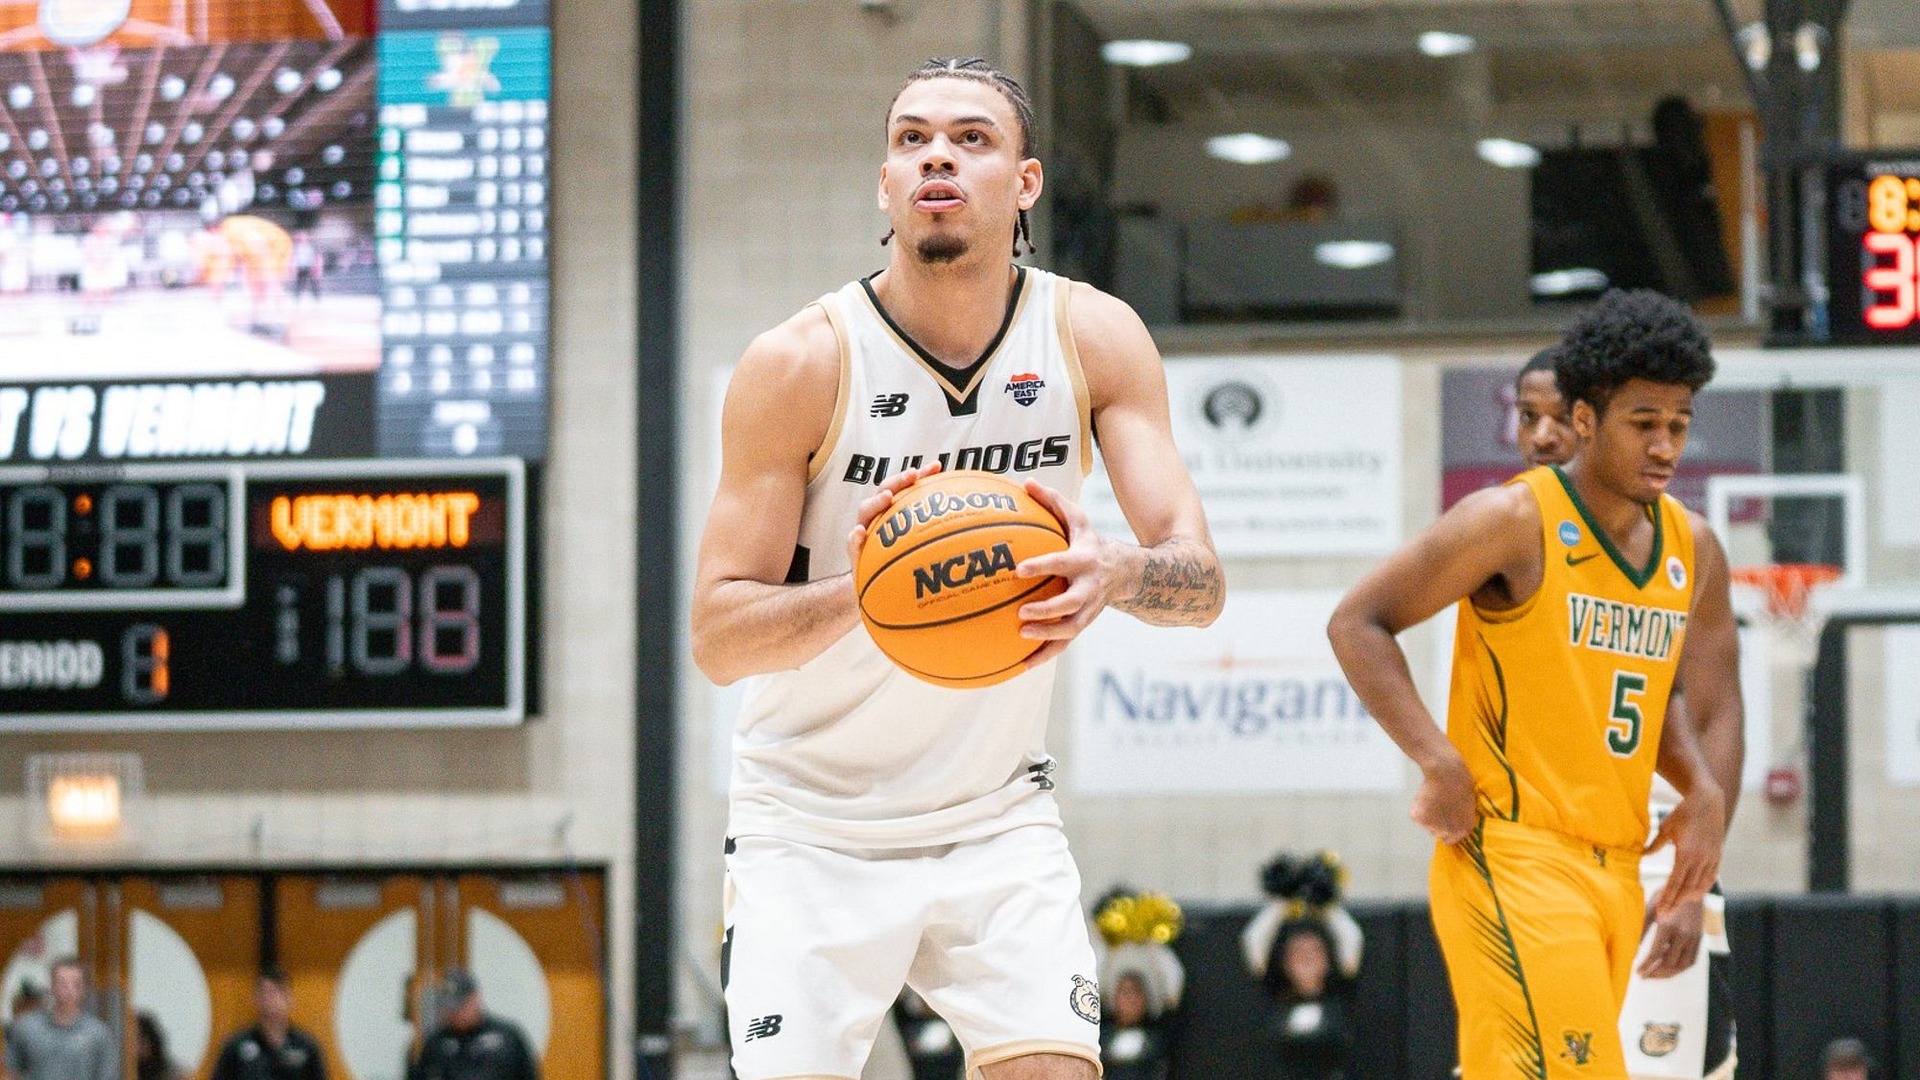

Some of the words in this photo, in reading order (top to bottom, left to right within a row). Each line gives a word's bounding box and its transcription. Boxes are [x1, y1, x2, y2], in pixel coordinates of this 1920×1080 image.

[1863, 230, 1920, 330] 3
[1004, 380, 1046, 393] AMERICA
[1013, 389, 1038, 398] EAST
[842, 434, 1072, 487] BUDOGS
[271, 492, 480, 550] VERMONT
[876, 491, 1019, 548] Wilson
[913, 543, 1017, 600] NCAA
[1604, 668, 1648, 759] 5
